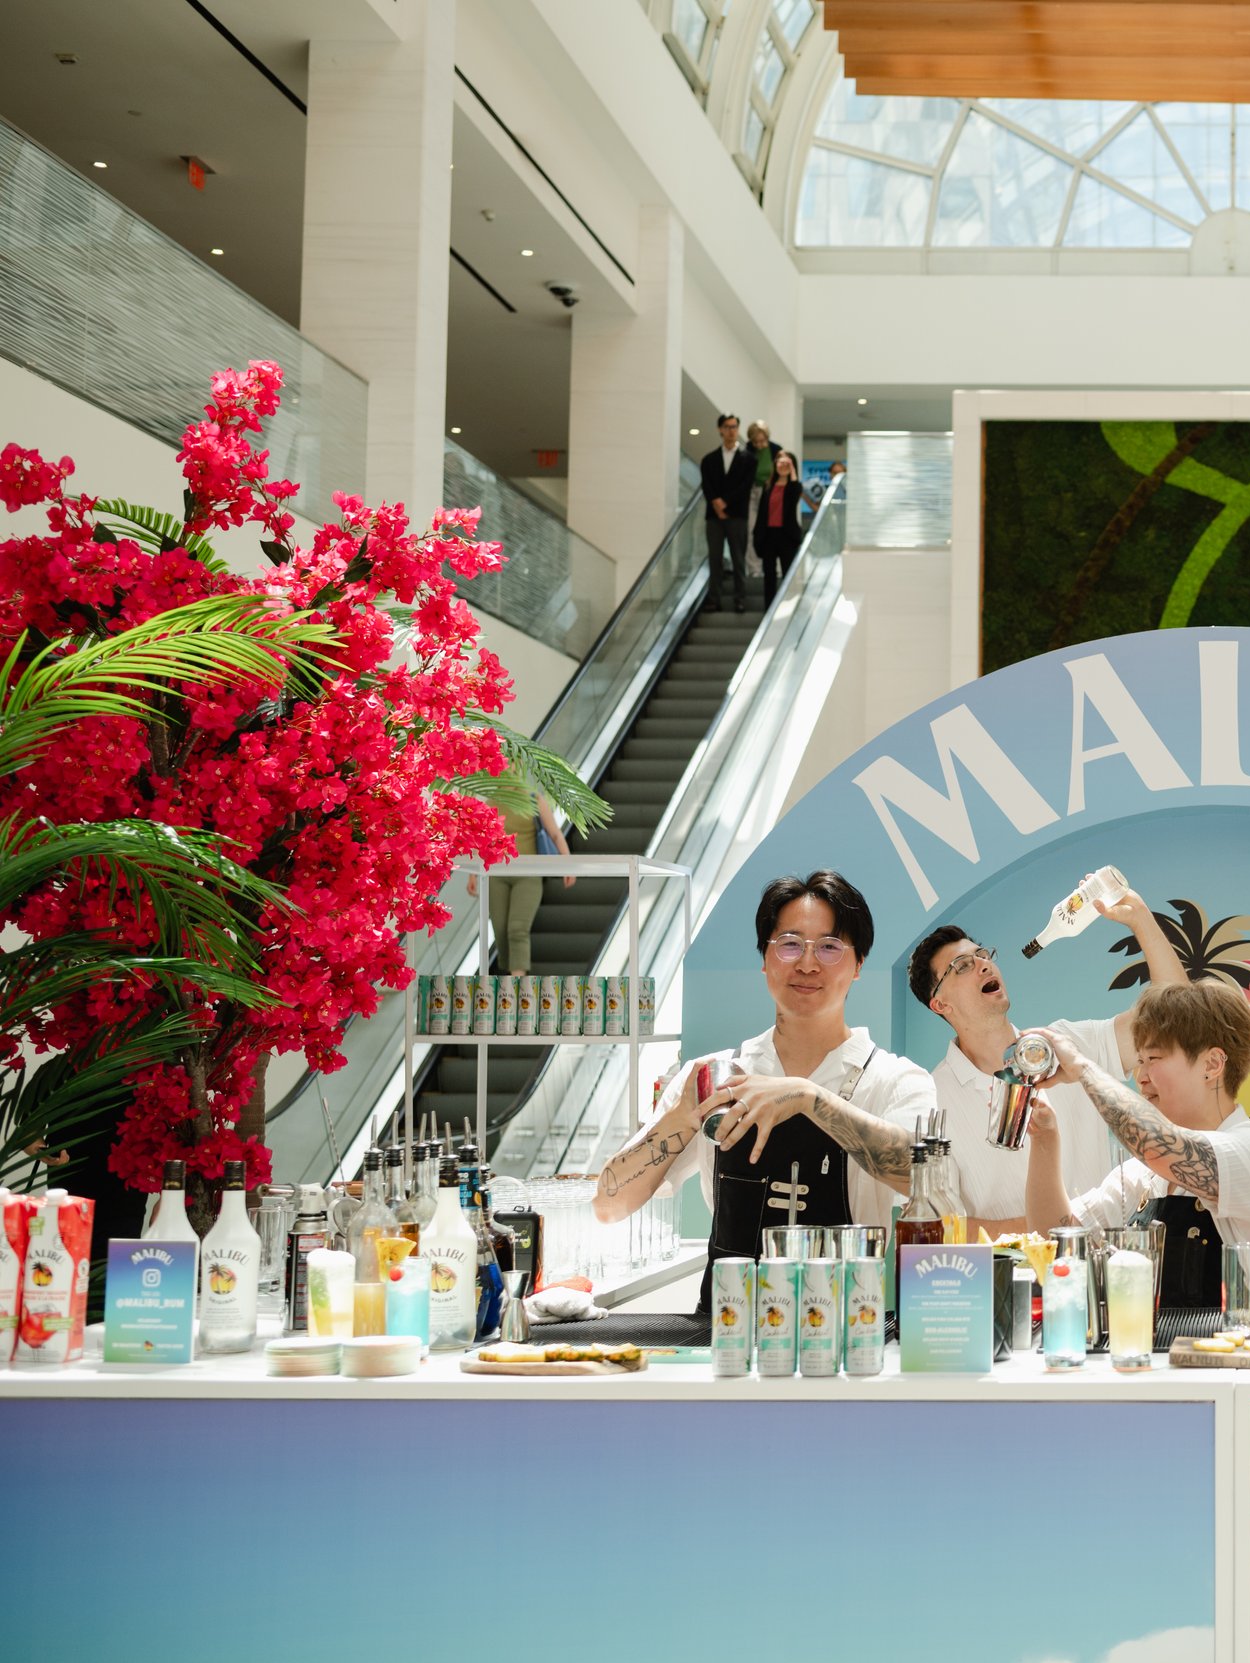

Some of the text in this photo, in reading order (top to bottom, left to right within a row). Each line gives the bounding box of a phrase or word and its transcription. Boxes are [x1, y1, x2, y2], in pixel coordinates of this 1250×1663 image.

[131, 1248, 174, 1266] MALIBU
[203, 1248, 250, 1266] MALIBU
[915, 1253, 978, 1279] MALIBU
